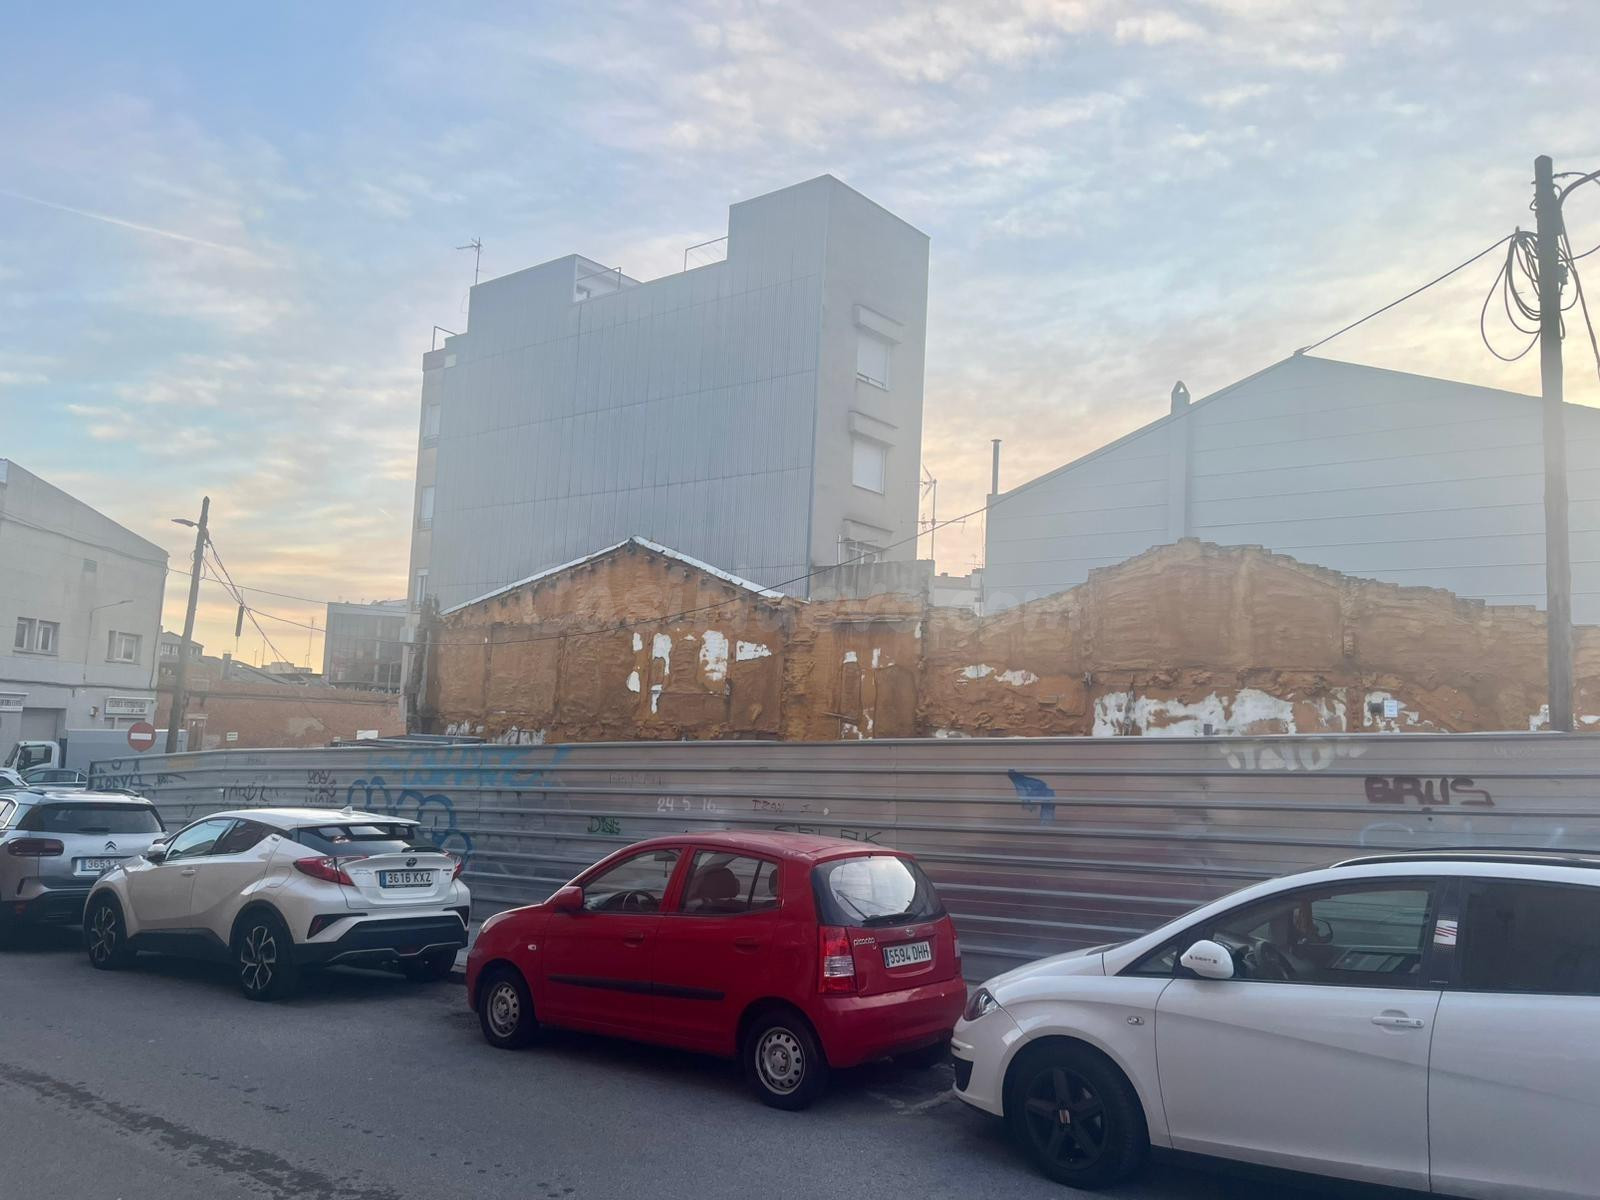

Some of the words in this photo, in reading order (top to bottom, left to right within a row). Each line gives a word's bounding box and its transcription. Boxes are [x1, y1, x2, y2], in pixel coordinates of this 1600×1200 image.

[656, 797, 674, 812] 24
[387, 873, 411, 884] 3616
[413, 872, 432, 883] KXZ
[888, 947, 911, 964] 5594
[911, 944, 930, 960] DHH
